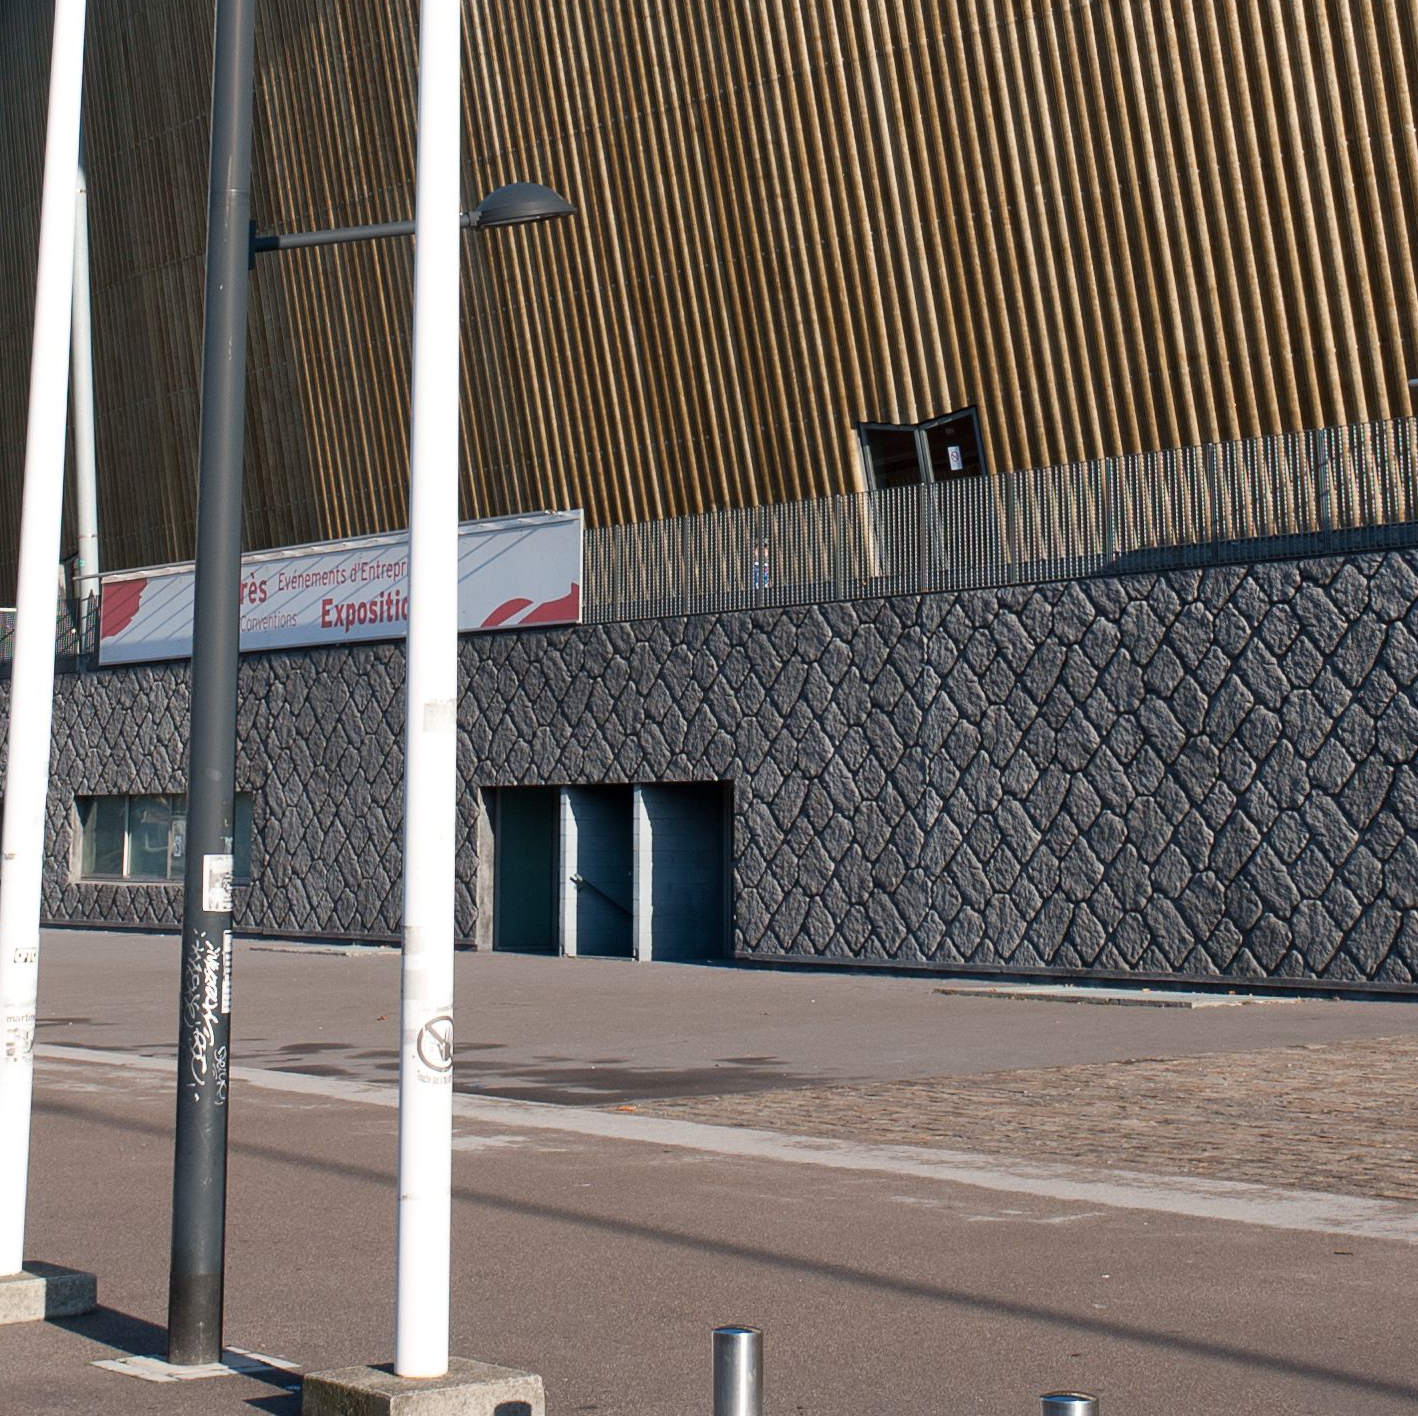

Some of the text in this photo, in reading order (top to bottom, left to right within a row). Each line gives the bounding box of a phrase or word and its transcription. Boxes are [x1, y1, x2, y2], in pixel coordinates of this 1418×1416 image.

[278, 559, 407, 592] Evénements d'Entrepr
[241, 609, 298, 633] Conventions
